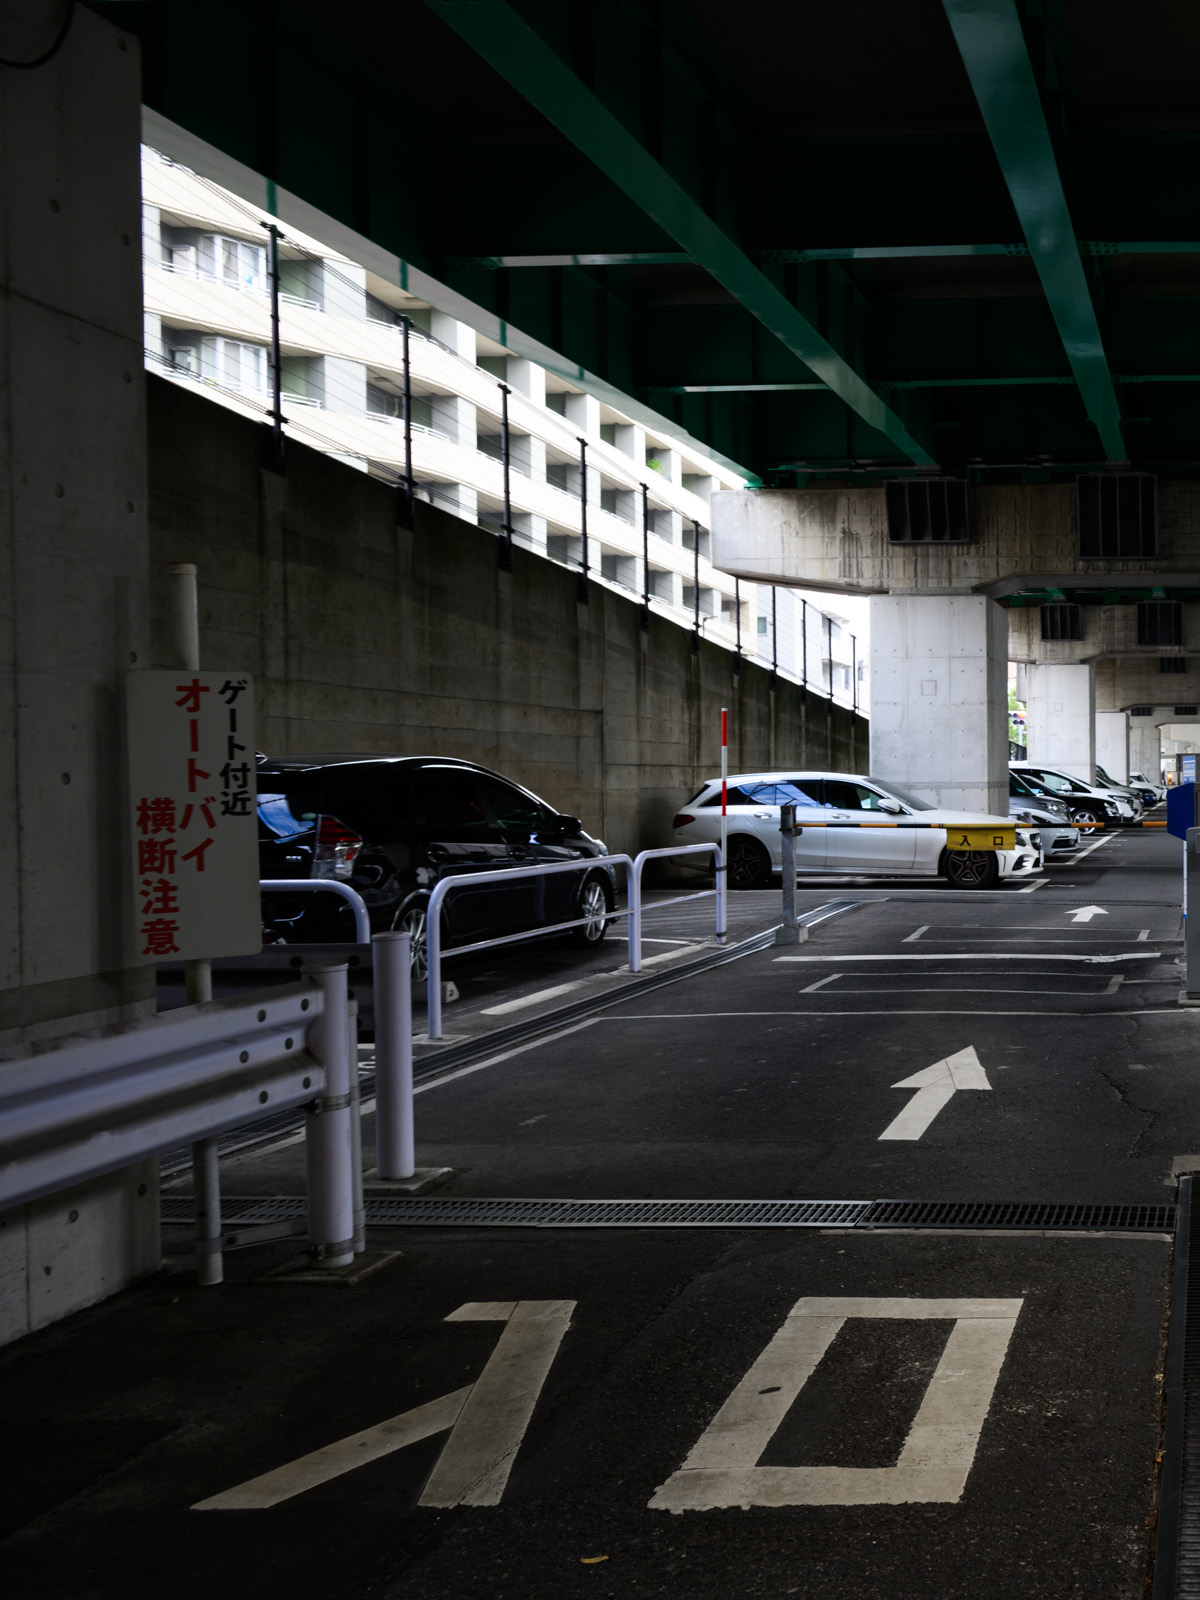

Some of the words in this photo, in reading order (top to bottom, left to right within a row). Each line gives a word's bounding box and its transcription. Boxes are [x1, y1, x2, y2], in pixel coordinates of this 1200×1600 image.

[174, 678, 217, 873] オートバイ
[218, 679, 252, 817] ゲート付近
[136, 797, 180, 957] 横断注意
[960, 835, 1004, 846] 入口
[191, 1298, 1025, 1514] 入口
